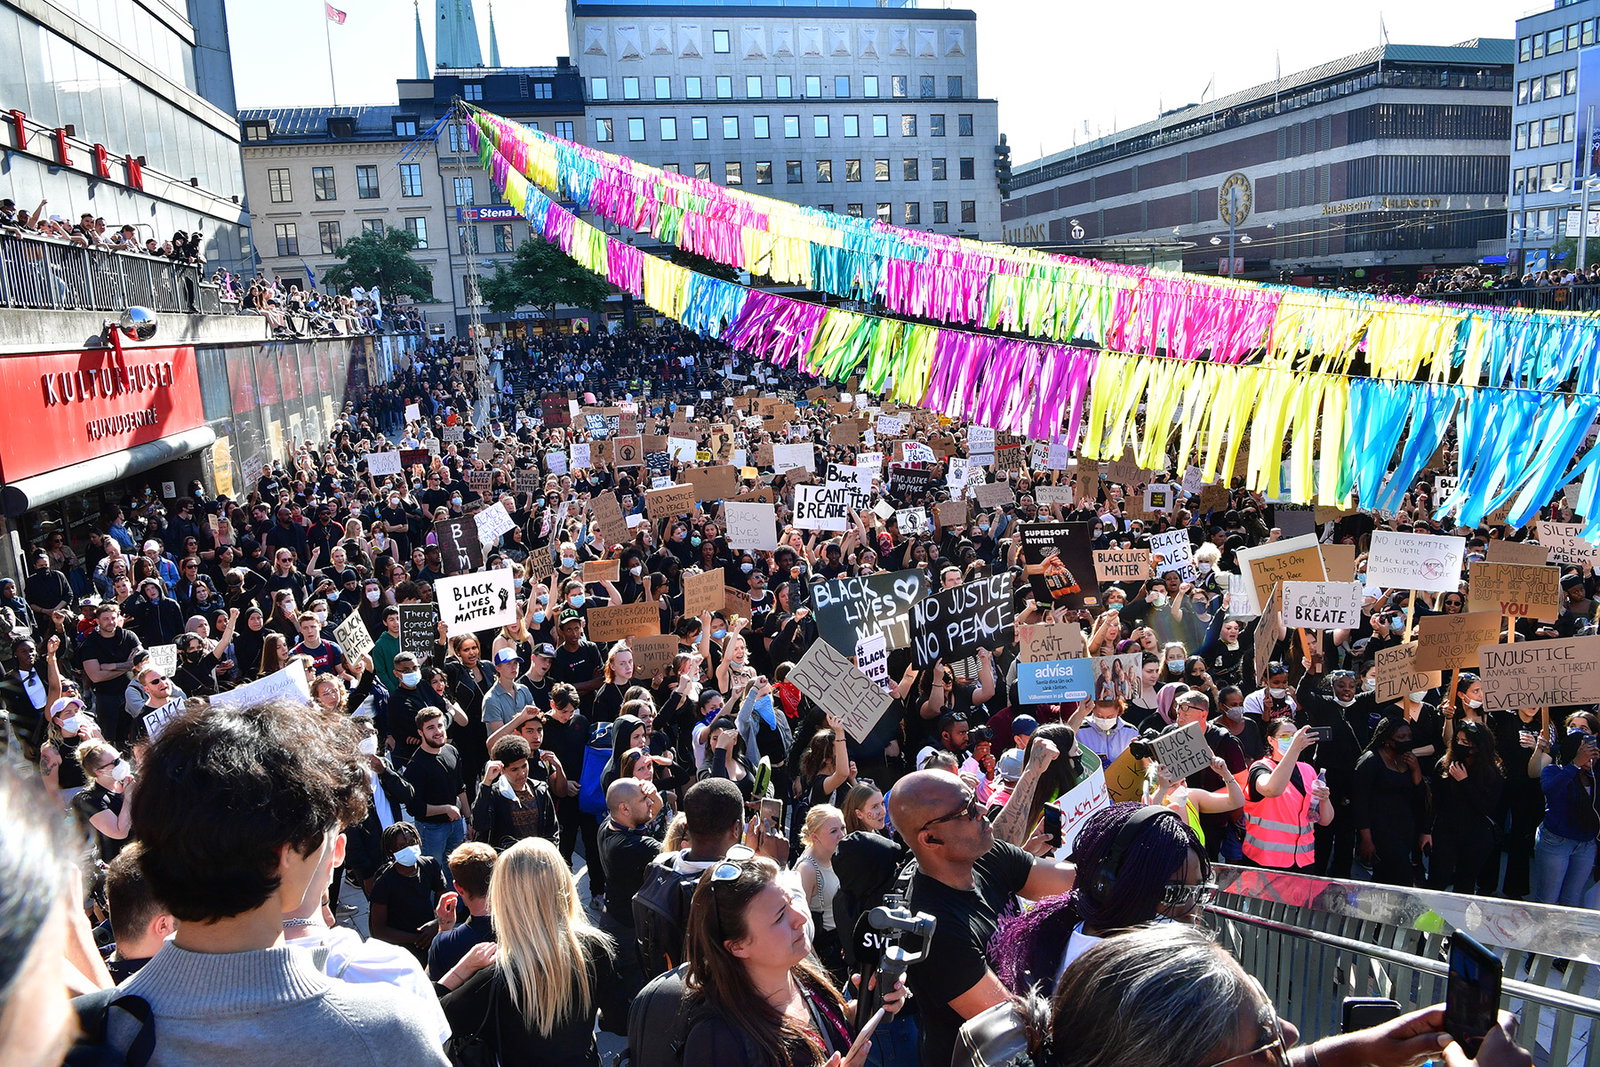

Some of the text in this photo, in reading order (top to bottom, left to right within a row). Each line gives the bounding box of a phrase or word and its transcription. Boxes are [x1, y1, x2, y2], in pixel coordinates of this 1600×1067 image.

[480, 208, 512, 218] Stena
[43, 361, 174, 406] KULTURHUSET
[370, 456, 398, 465] BLACK
[828, 464, 858, 483] Black
[652, 491, 694, 504] NO JUSTICE
[804, 488, 808, 502] I
[652, 507, 664, 515] NO
[726, 508, 760, 524] BLACK
[796, 502, 847, 518] BREATHE
[730, 524, 760, 537] LIVES
[1543, 524, 1582, 536] SILEN
[1152, 532, 1188, 549] BLACK
[1374, 536, 1450, 550] NO LIVES MATTER
[1562, 538, 1574, 547] IS
[1098, 552, 1146, 562] BLACK LIVES
[1545, 544, 1598, 556] VIOLENCE
[1277, 558, 1288, 569] Is
[1374, 556, 1400, 564] BLACK
[1553, 554, 1588, 564] #BLM
[1104, 564, 1140, 576] MATTER
[1269, 574, 1284, 582] One
[1475, 563, 1559, 584] I MIGHT
[452, 582, 494, 602] BLACK
[1316, 584, 1326, 594] I
[1474, 580, 1504, 589] NOT
[814, 576, 878, 610] BLACK
[913, 573, 1012, 628] NO JUSTICE
[1475, 589, 1558, 606] BUT I FEEL
[458, 596, 490, 610] LIVES
[844, 594, 897, 624] LIVES
[1500, 601, 1528, 616] YOU
[404, 610, 430, 619] There
[454, 606, 496, 624] MATTER
[592, 611, 606, 620] ERIC
[1295, 606, 1347, 624] BREATE
[336, 614, 362, 642] BLACK
[854, 613, 910, 648] MATT
[914, 602, 1014, 667] NO PEACE
[1044, 624, 1056, 638] I
[343, 627, 365, 652] LIVES
[1420, 628, 1497, 646] JUSTICE
[150, 646, 176, 658] BLACK
[347, 634, 372, 664] MATTER
[856, 646, 864, 657] #
[1438, 644, 1479, 658] NOW
[154, 656, 174, 666] LIVES
[858, 649, 886, 668] BLACK
[1484, 646, 1576, 670] INJUSTICE
[164, 667, 174, 676] TER
[794, 644, 848, 701] BLACK
[866, 666, 886, 680] IVES
[1486, 662, 1598, 678] ANYWHERE IS A THREAT
[822, 666, 871, 715] LIVES
[1484, 674, 1584, 692] TO JUSTICE
[1484, 690, 1579, 710] EVERYWHERE
[146, 698, 182, 733] BLACK
[842, 684, 889, 740] MATTER
[1157, 727, 1194, 756] BLACK
[1166, 744, 1192, 766] LIVES
[1168, 750, 1212, 777] MATTER
[1108, 764, 1144, 801] ACK
